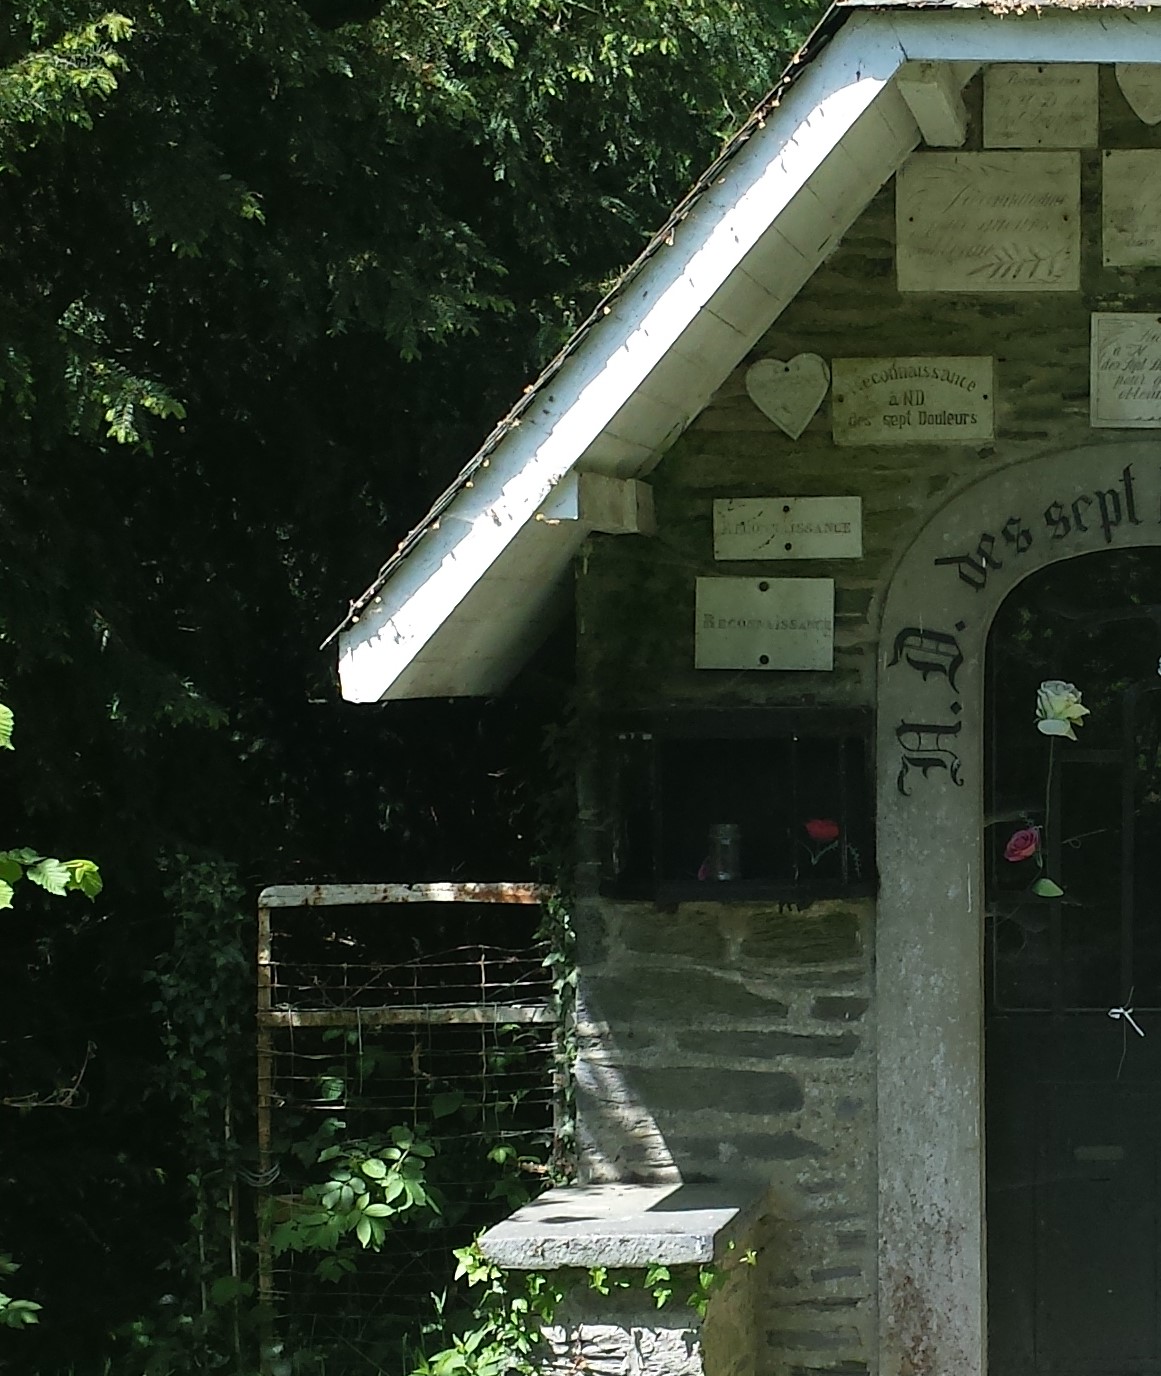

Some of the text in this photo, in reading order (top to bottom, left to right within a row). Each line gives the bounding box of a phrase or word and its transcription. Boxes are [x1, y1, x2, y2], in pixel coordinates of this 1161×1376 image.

[848, 410, 977, 429] des sept Douleurs
[721, 521, 852, 535] RECOISSANCE
[934, 516, 1033, 592] des
[1044, 463, 1143, 544] sept
